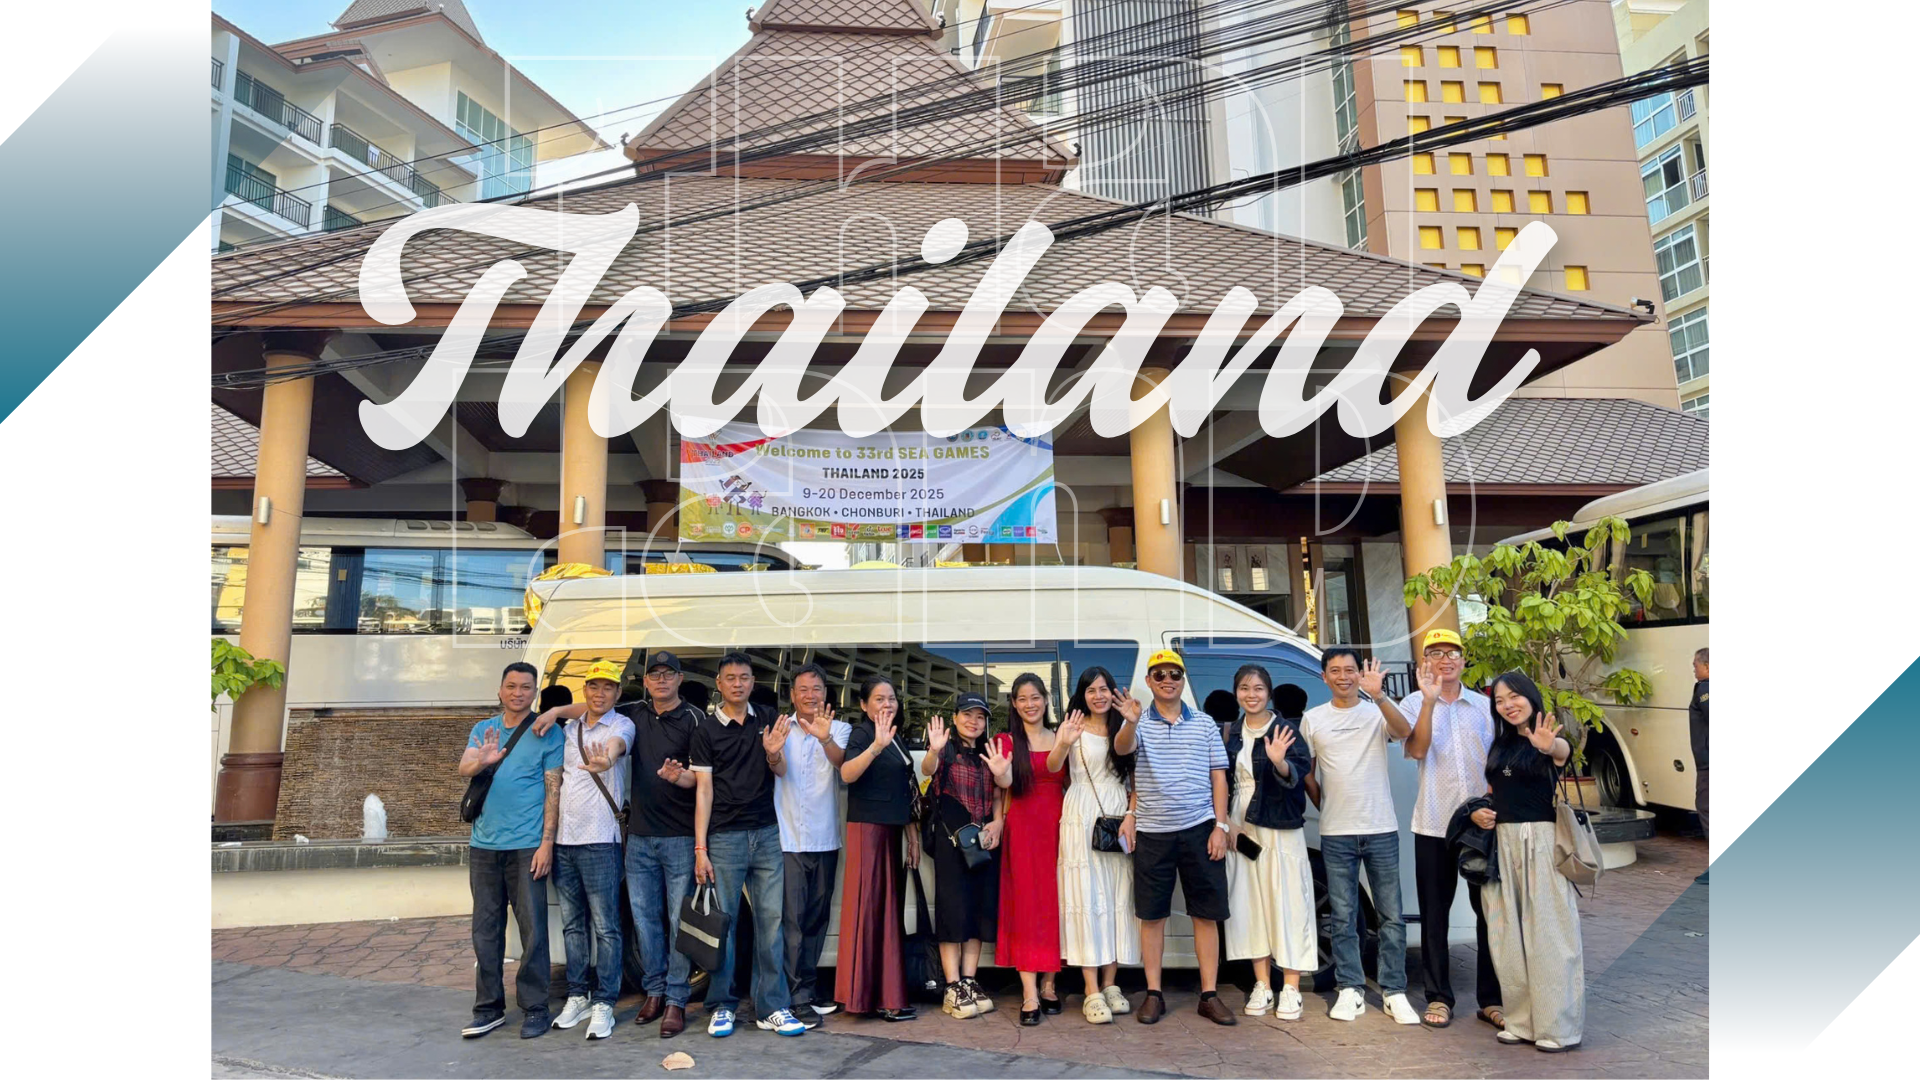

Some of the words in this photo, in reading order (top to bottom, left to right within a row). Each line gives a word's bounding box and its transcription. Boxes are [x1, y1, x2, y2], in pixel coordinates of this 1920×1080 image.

[755, 444, 831, 459] Welcome
[835, 447, 852, 459] to
[856, 446, 894, 460] 33rd
[898, 446, 929, 460] SEA
[933, 446, 990, 460] GAMES
[822, 467, 889, 479] THAILAND
[892, 468, 925, 480] 2025
[802, 487, 836, 499] 9-20
[839, 487, 907, 500] December
[910, 488, 945, 500] 2025
[771, 506, 831, 518] BANGKOK
[841, 507, 904, 518] CHONBURI
[915, 507, 975, 518] THAILAND
